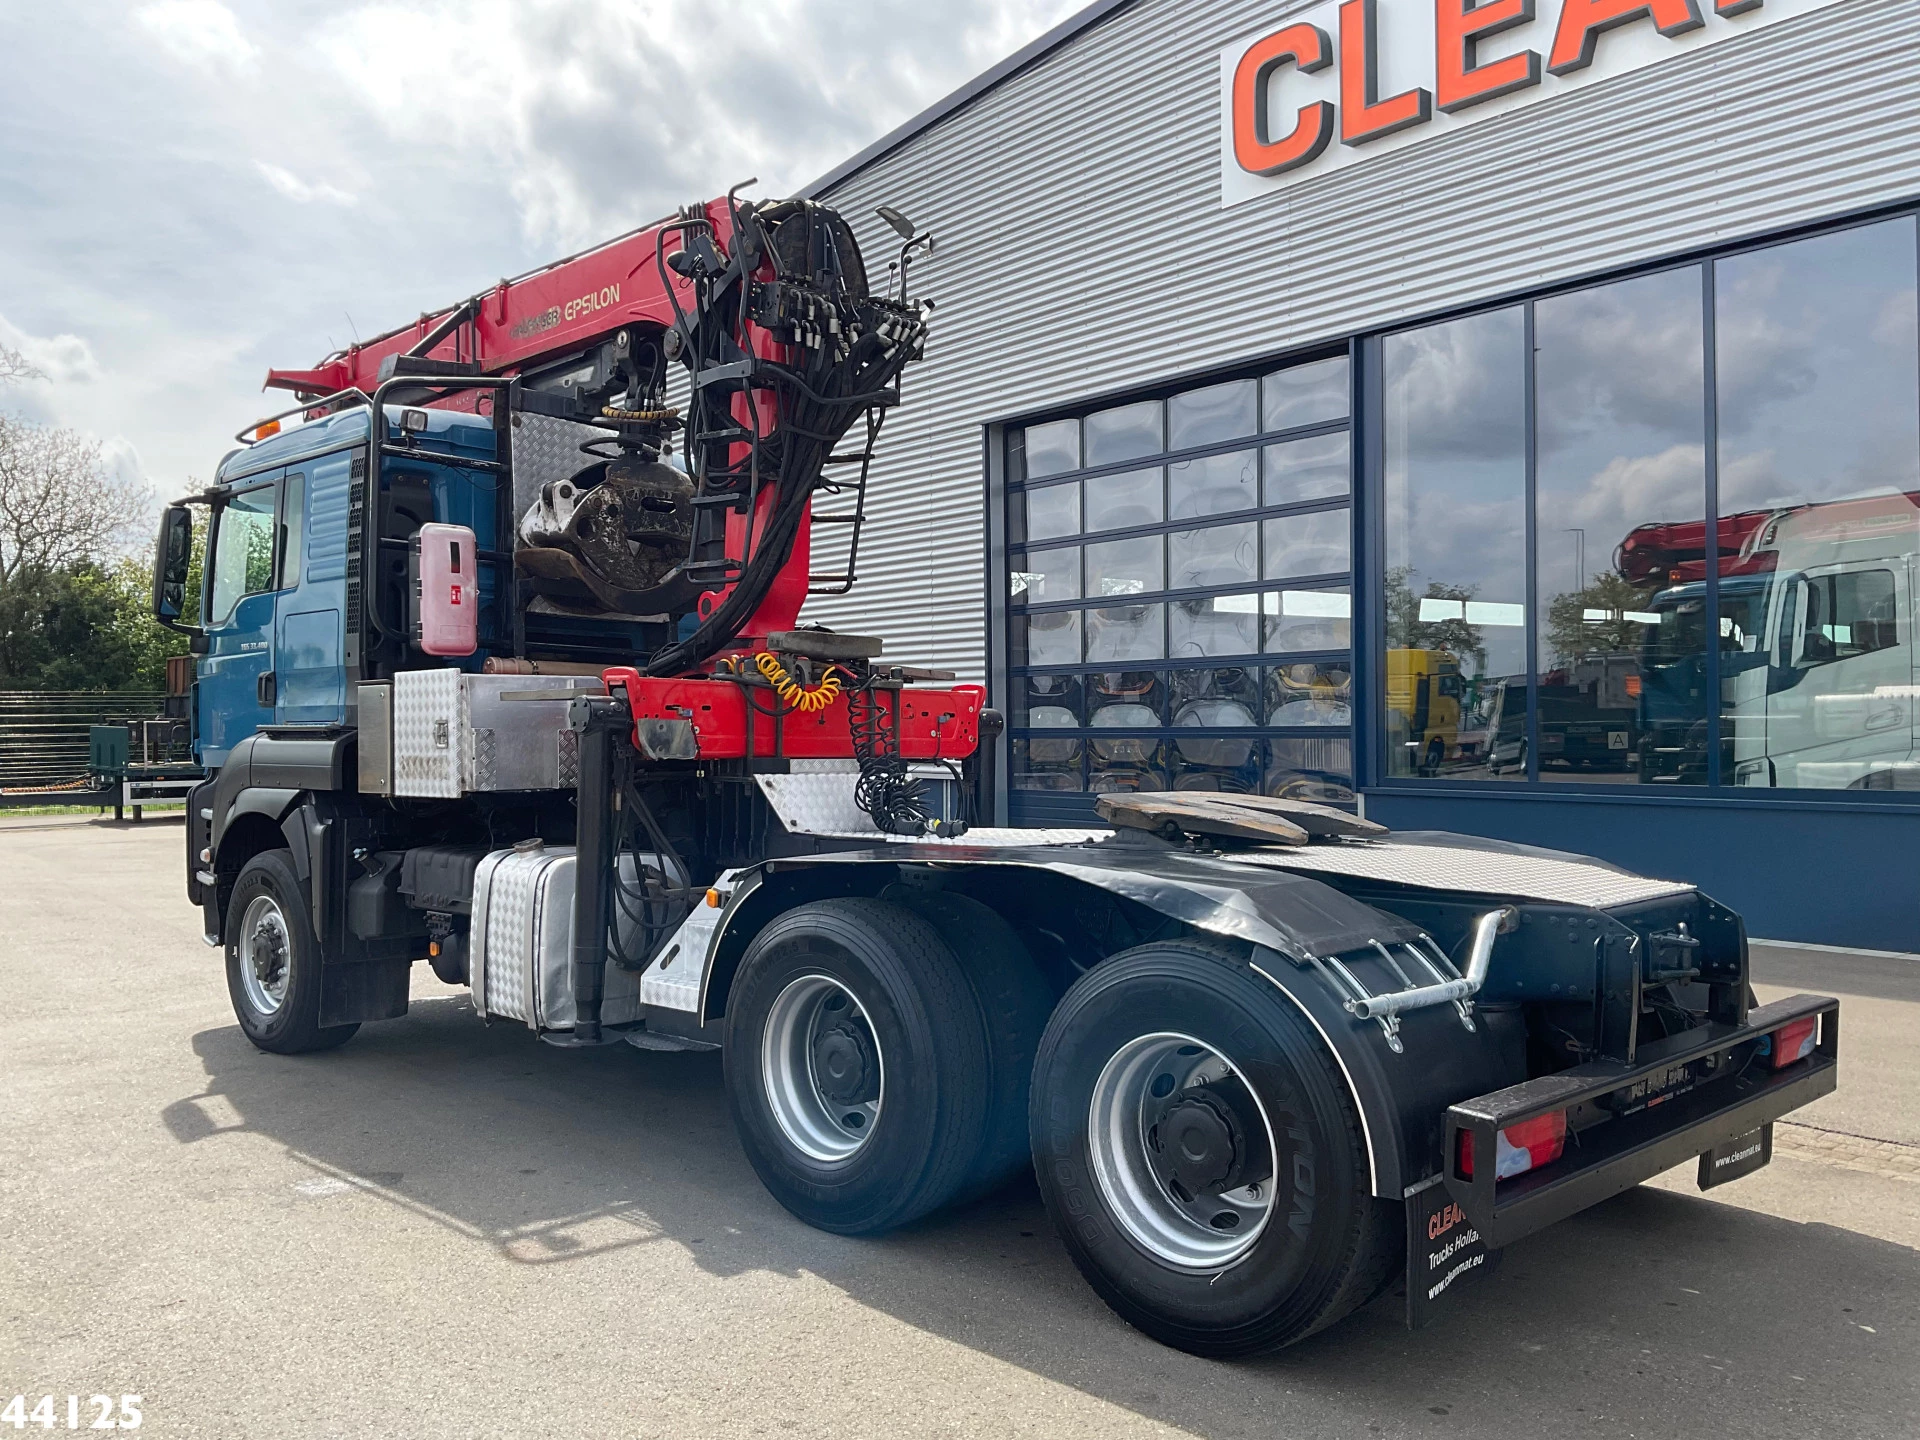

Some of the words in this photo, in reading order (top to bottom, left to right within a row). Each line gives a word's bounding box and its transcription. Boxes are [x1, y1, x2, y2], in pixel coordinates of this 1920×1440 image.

[1232, 0, 1763, 178] CLEA
[564, 283, 620, 321] EPSILON
[1715, 1142, 1761, 1168] www.cleanmat.eu
[1428, 1242, 1454, 1270] Trucks
[1429, 1254, 1484, 1300] www.cleanmat.eu
